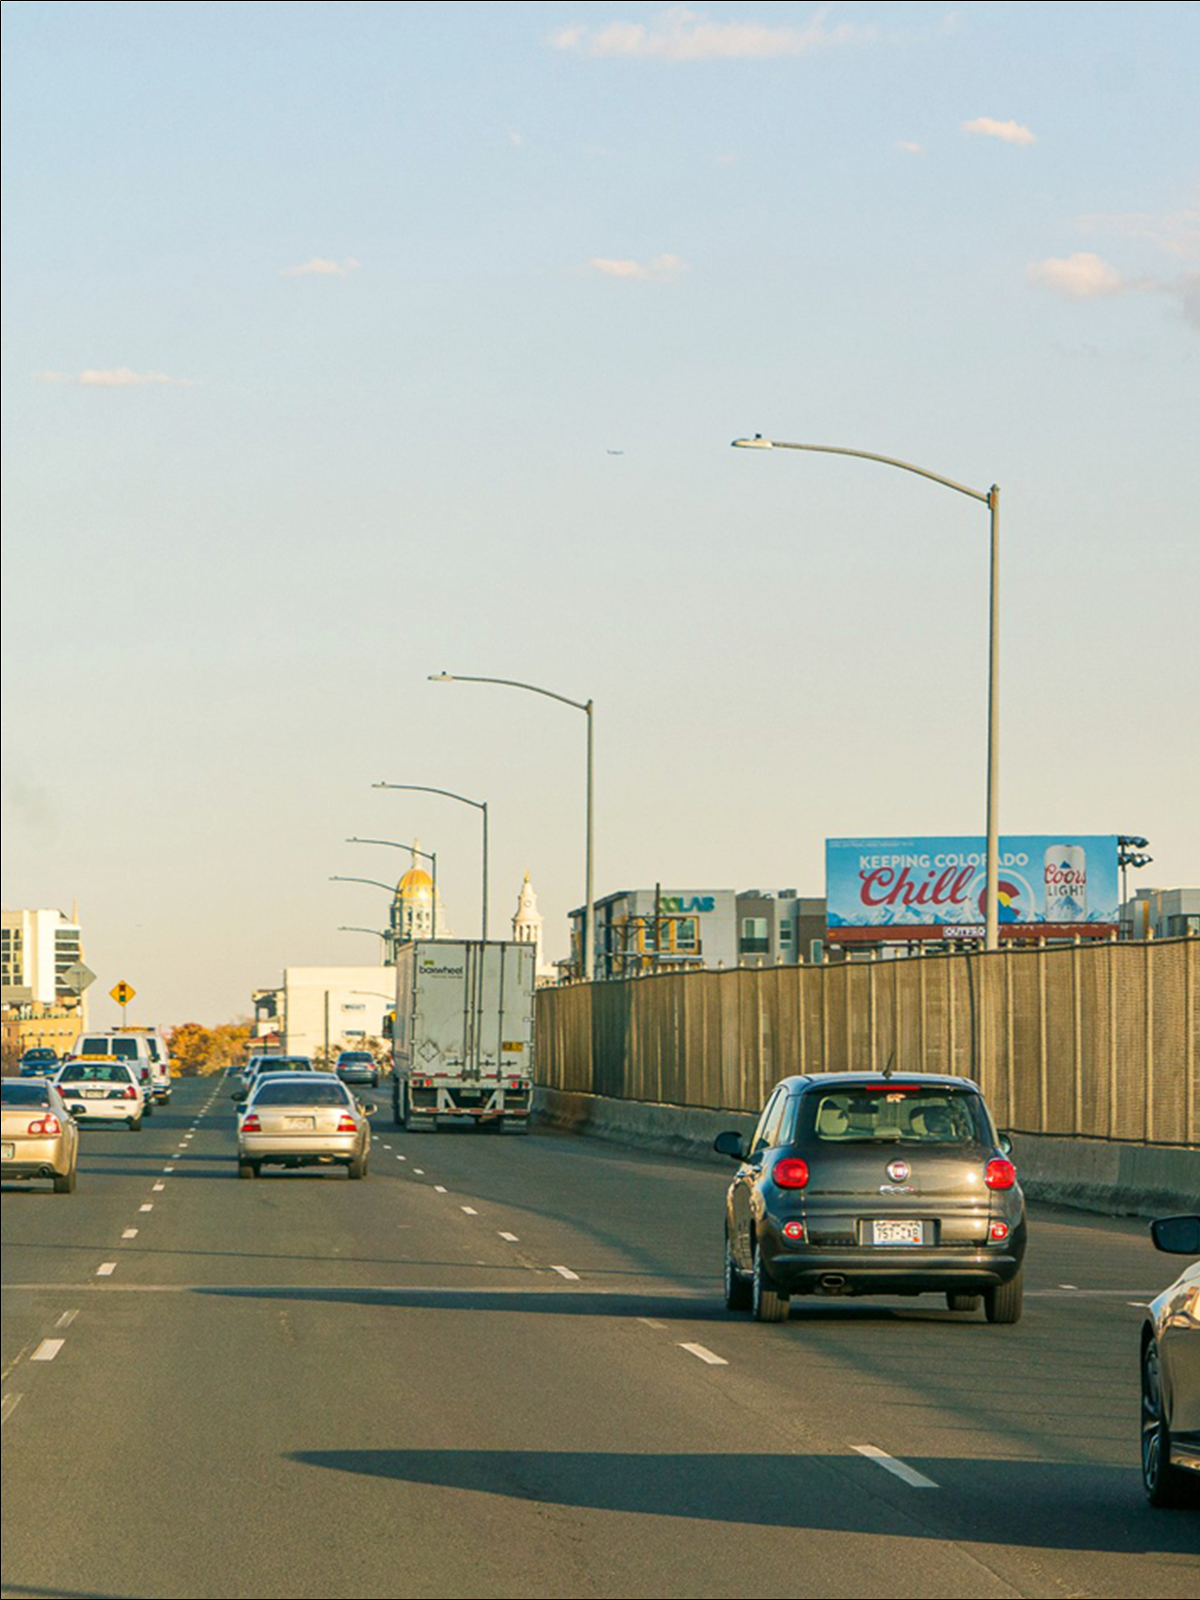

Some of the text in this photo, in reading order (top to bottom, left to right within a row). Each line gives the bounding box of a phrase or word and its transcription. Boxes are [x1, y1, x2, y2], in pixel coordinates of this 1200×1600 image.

[859, 852, 1029, 868] KEEPING COLODO
[1044, 863, 1087, 885] Coors
[858, 865, 973, 906] Chill
[1048, 885, 1084, 896] LIGHT
[419, 966, 463, 974] boxwheel
